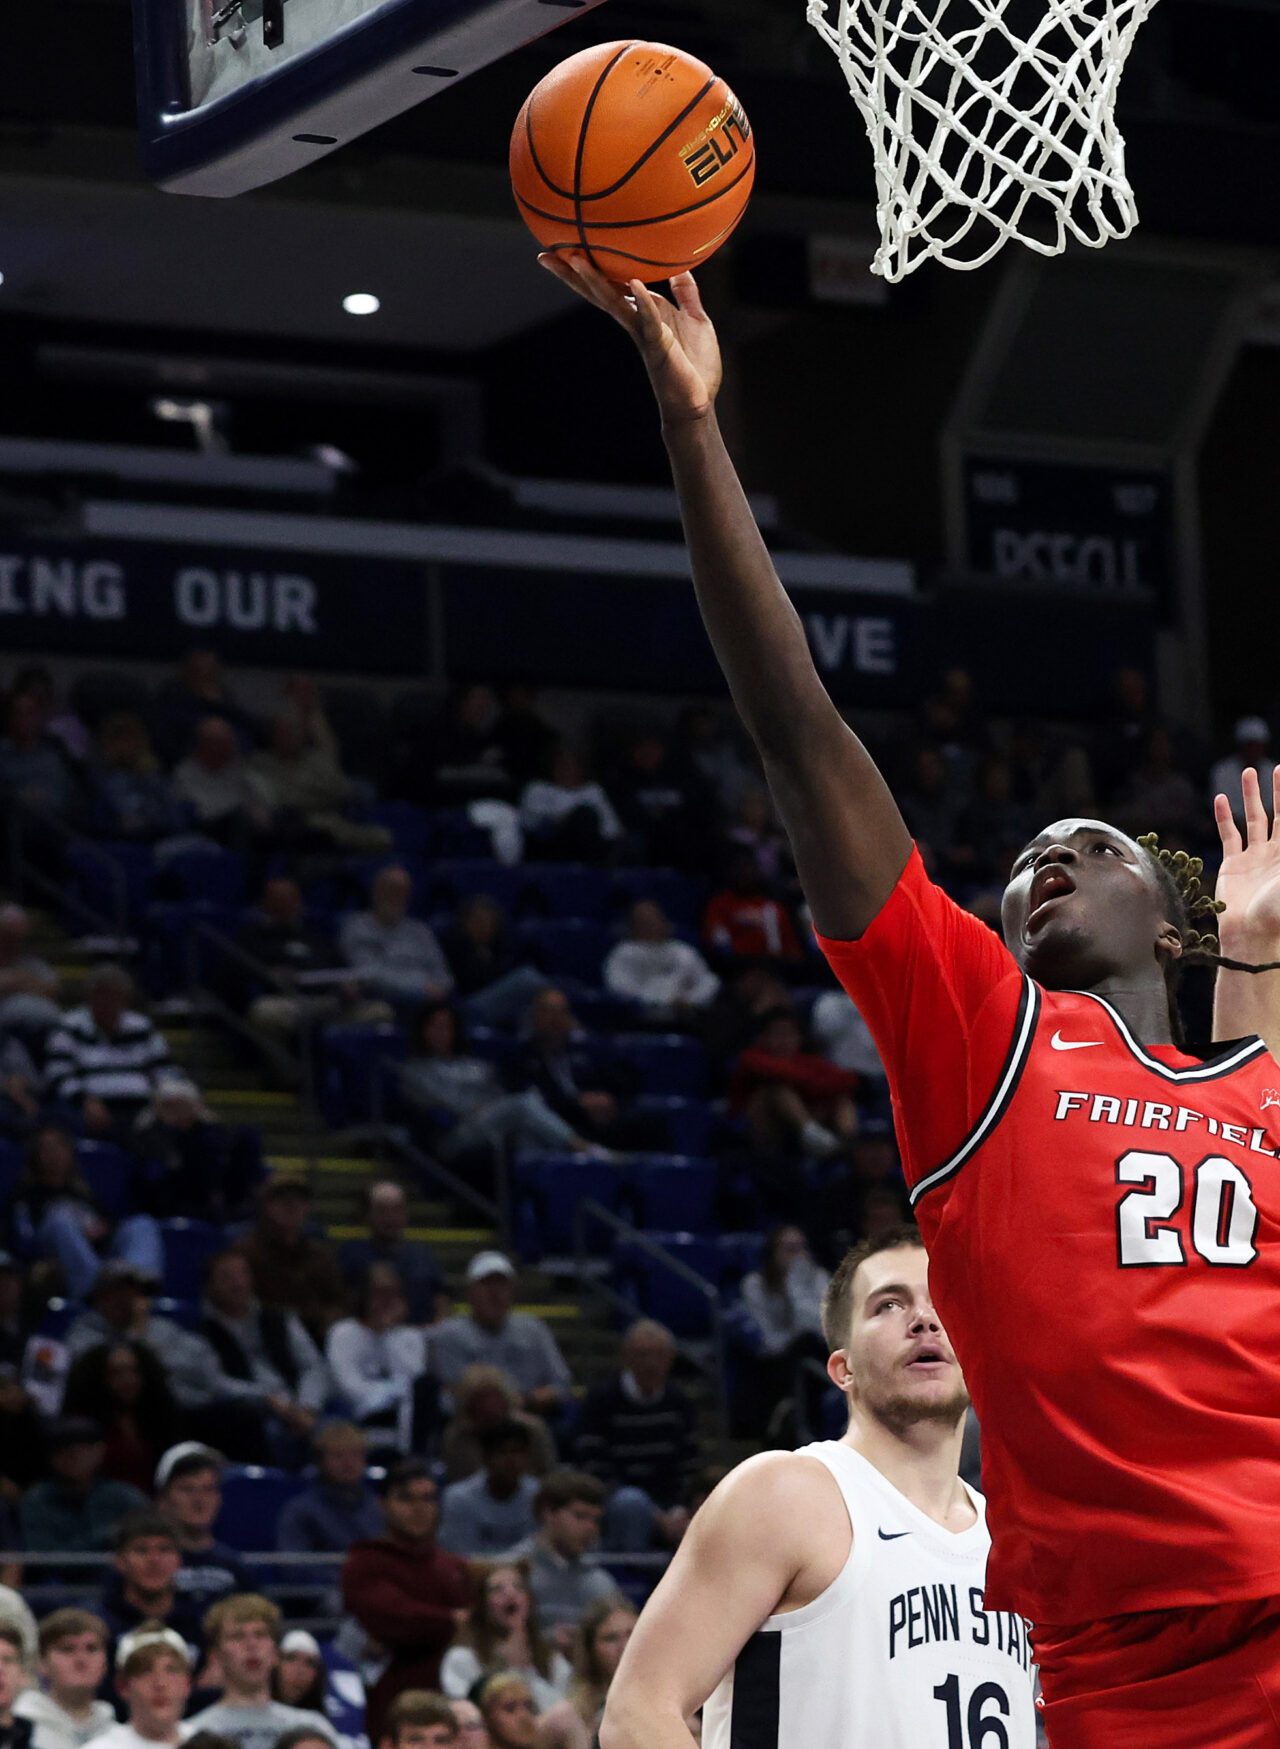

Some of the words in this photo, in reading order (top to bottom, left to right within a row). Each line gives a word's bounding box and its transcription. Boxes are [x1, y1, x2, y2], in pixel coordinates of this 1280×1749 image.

[176, 567, 317, 635] OUR
[806, 613, 896, 674] VE
[1115, 1148, 1260, 1268] 20
[889, 1583, 960, 1661] PENN
[933, 1673, 1010, 1749] 16
